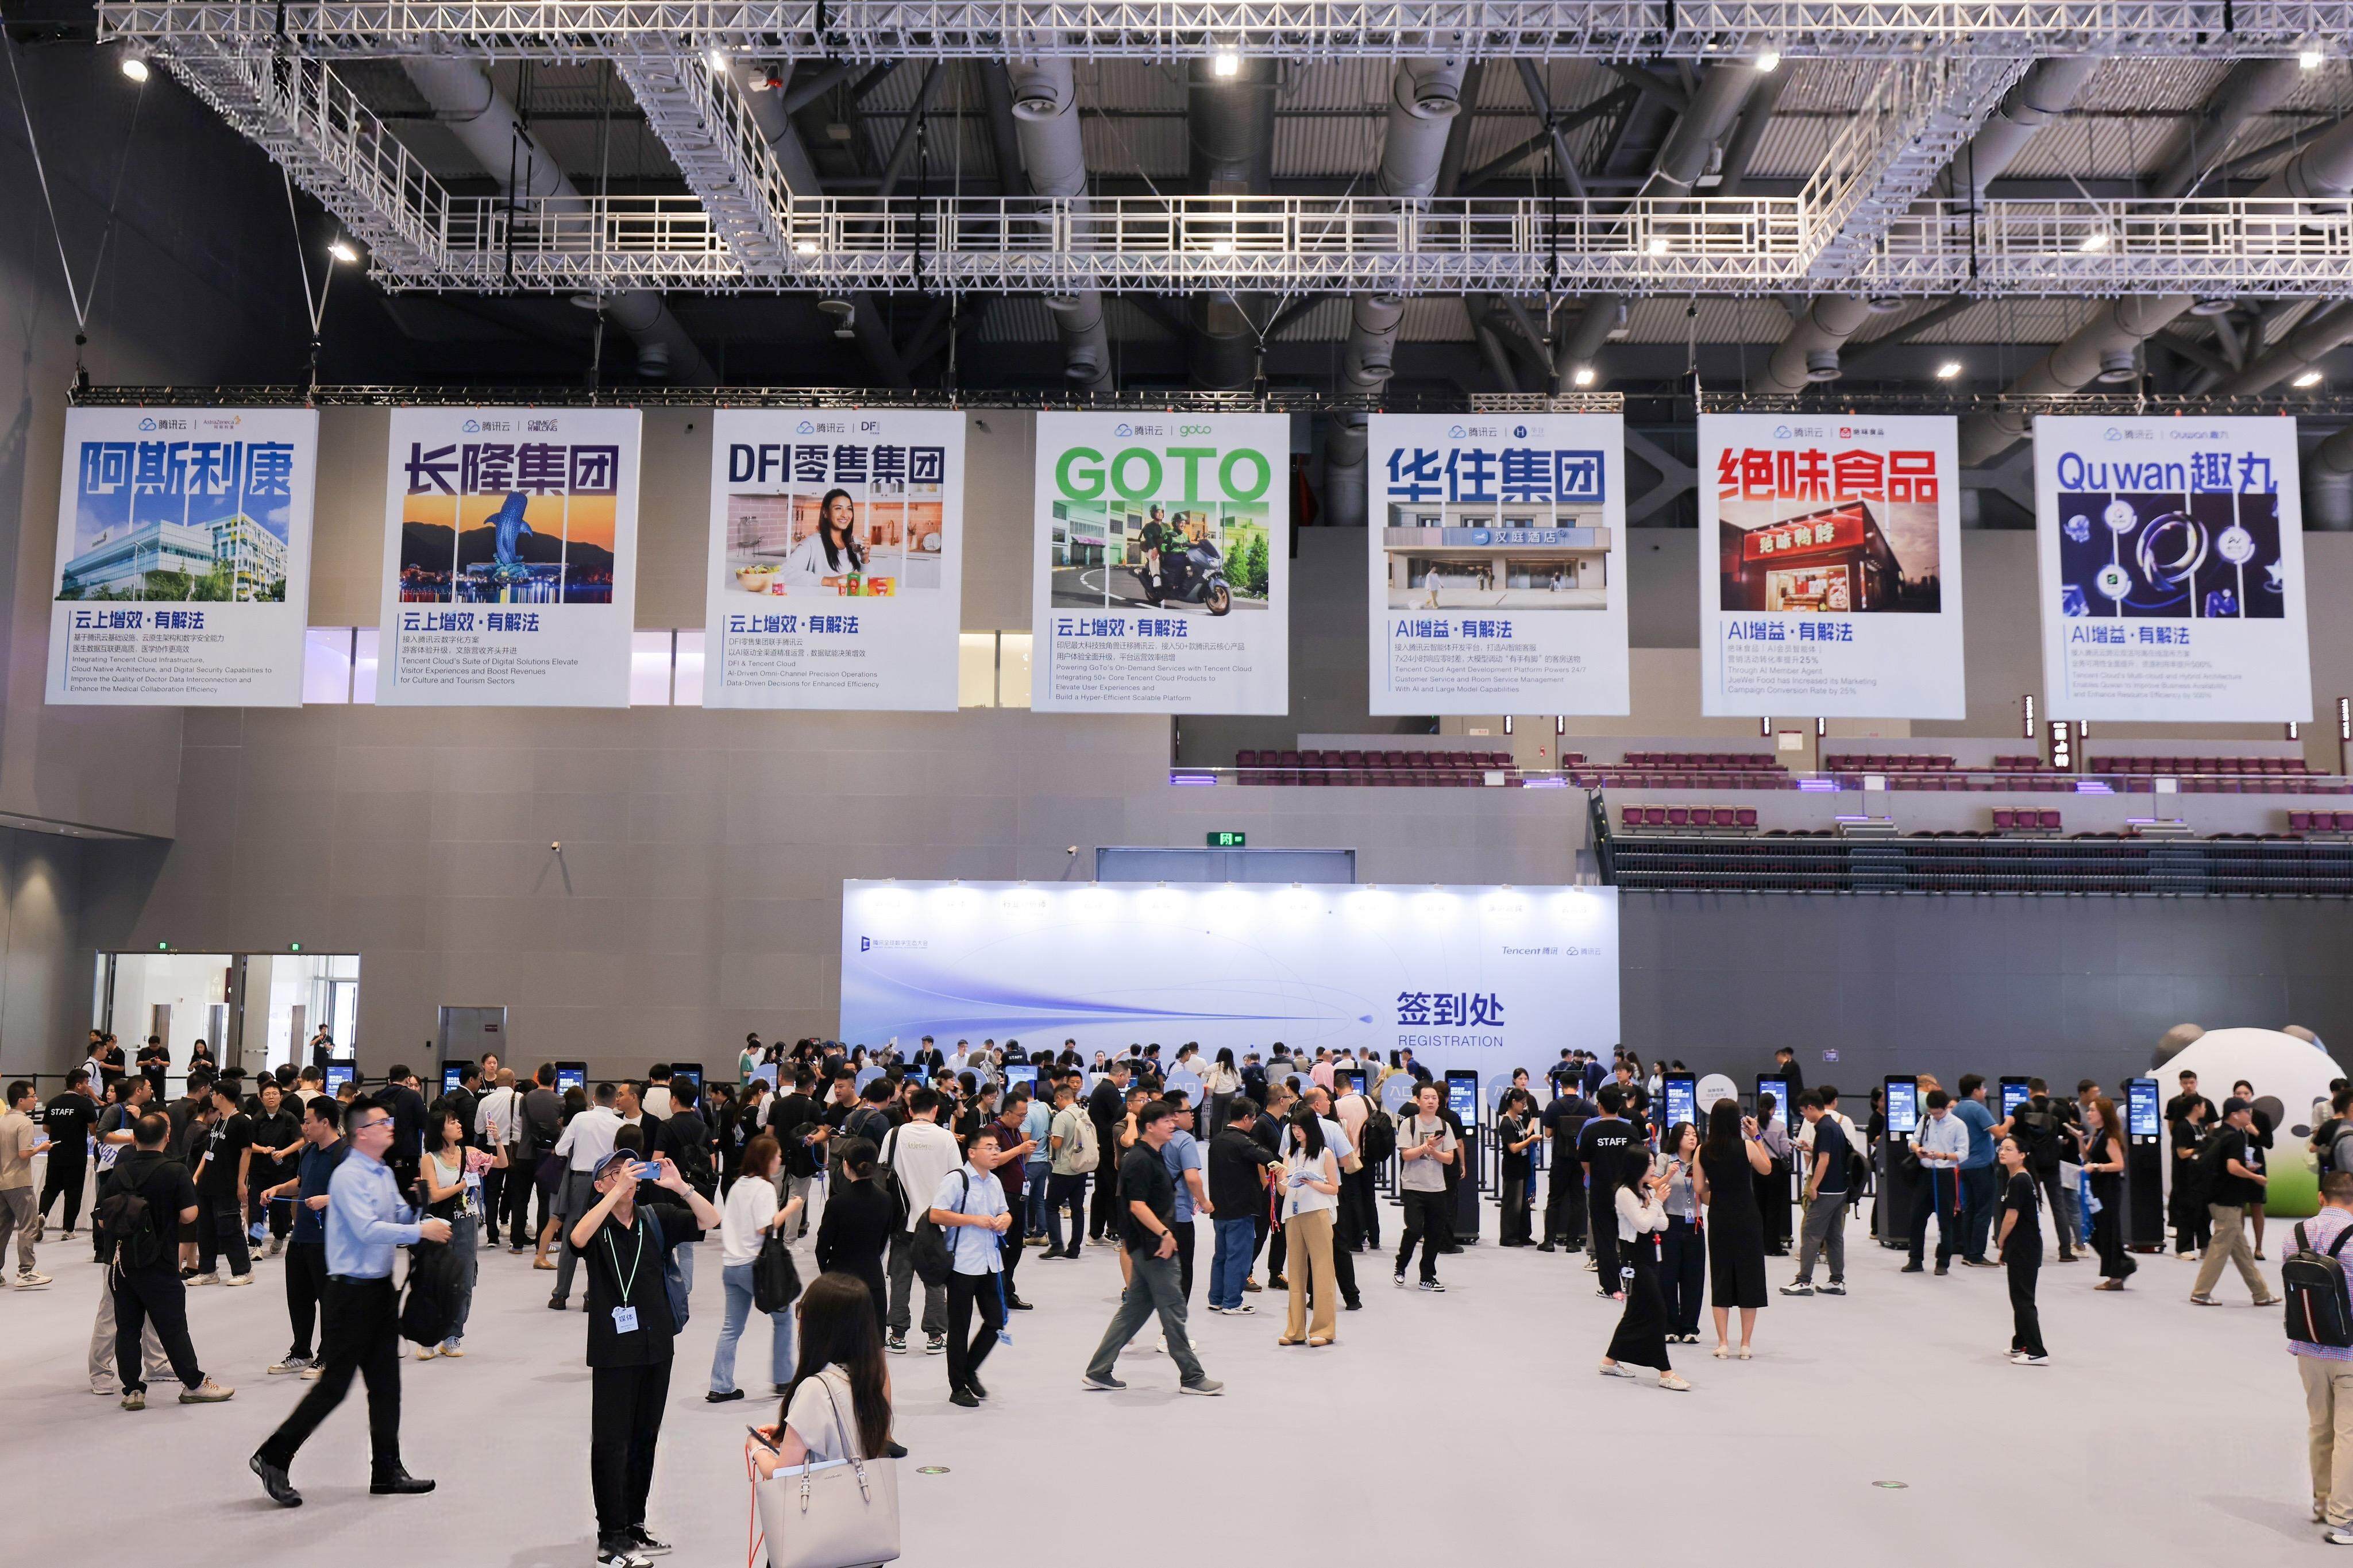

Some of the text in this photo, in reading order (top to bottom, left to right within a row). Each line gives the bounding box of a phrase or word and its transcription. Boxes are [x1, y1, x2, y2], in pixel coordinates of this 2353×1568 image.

[159, 420, 187, 430] 腾讯云
[482, 422, 510, 431] 腾讯云
[816, 423, 844, 432] 腾讯云
[1135, 426, 1163, 435] 腾讯云
[1180, 424, 1211, 437] goto
[1468, 427, 1497, 437] 腾讯云
[1793, 427, 1823, 437] 腾讯云
[79, 441, 294, 495] 阿斯利康
[404, 442, 619, 495] 长隆集团
[728, 443, 946, 484] DFI零售集团
[1055, 446, 1271, 501] GOTO
[1386, 448, 1604, 504] 华住集团
[1717, 448, 1938, 503] 绝味食品
[1495, 531, 1556, 543] 汉庭酒店
[75, 611, 205, 629] 云上增效·有解法
[404, 612, 539, 632] 云上增效·有解法
[730, 615, 859, 634] 云上增效·有解法
[1058, 618, 1188, 638] 云上增效·有解法
[1395, 619, 1513, 638] AI增益·有解法
[1728, 620, 1853, 642] AI增益·有解法
[402, 635, 479, 643] 接入腾讯云数字化方案
[728, 638, 803, 646] DFI零售集团联手腾讯云
[1502, 947, 1558, 955] Tencent 腾讯
[1397, 991, 1505, 1027] 签到处
[1398, 1035, 1503, 1046] REGISTRATION
[1597, 1138, 1627, 1146] STAFF
[619, 1314, 633, 1323] 媒体
